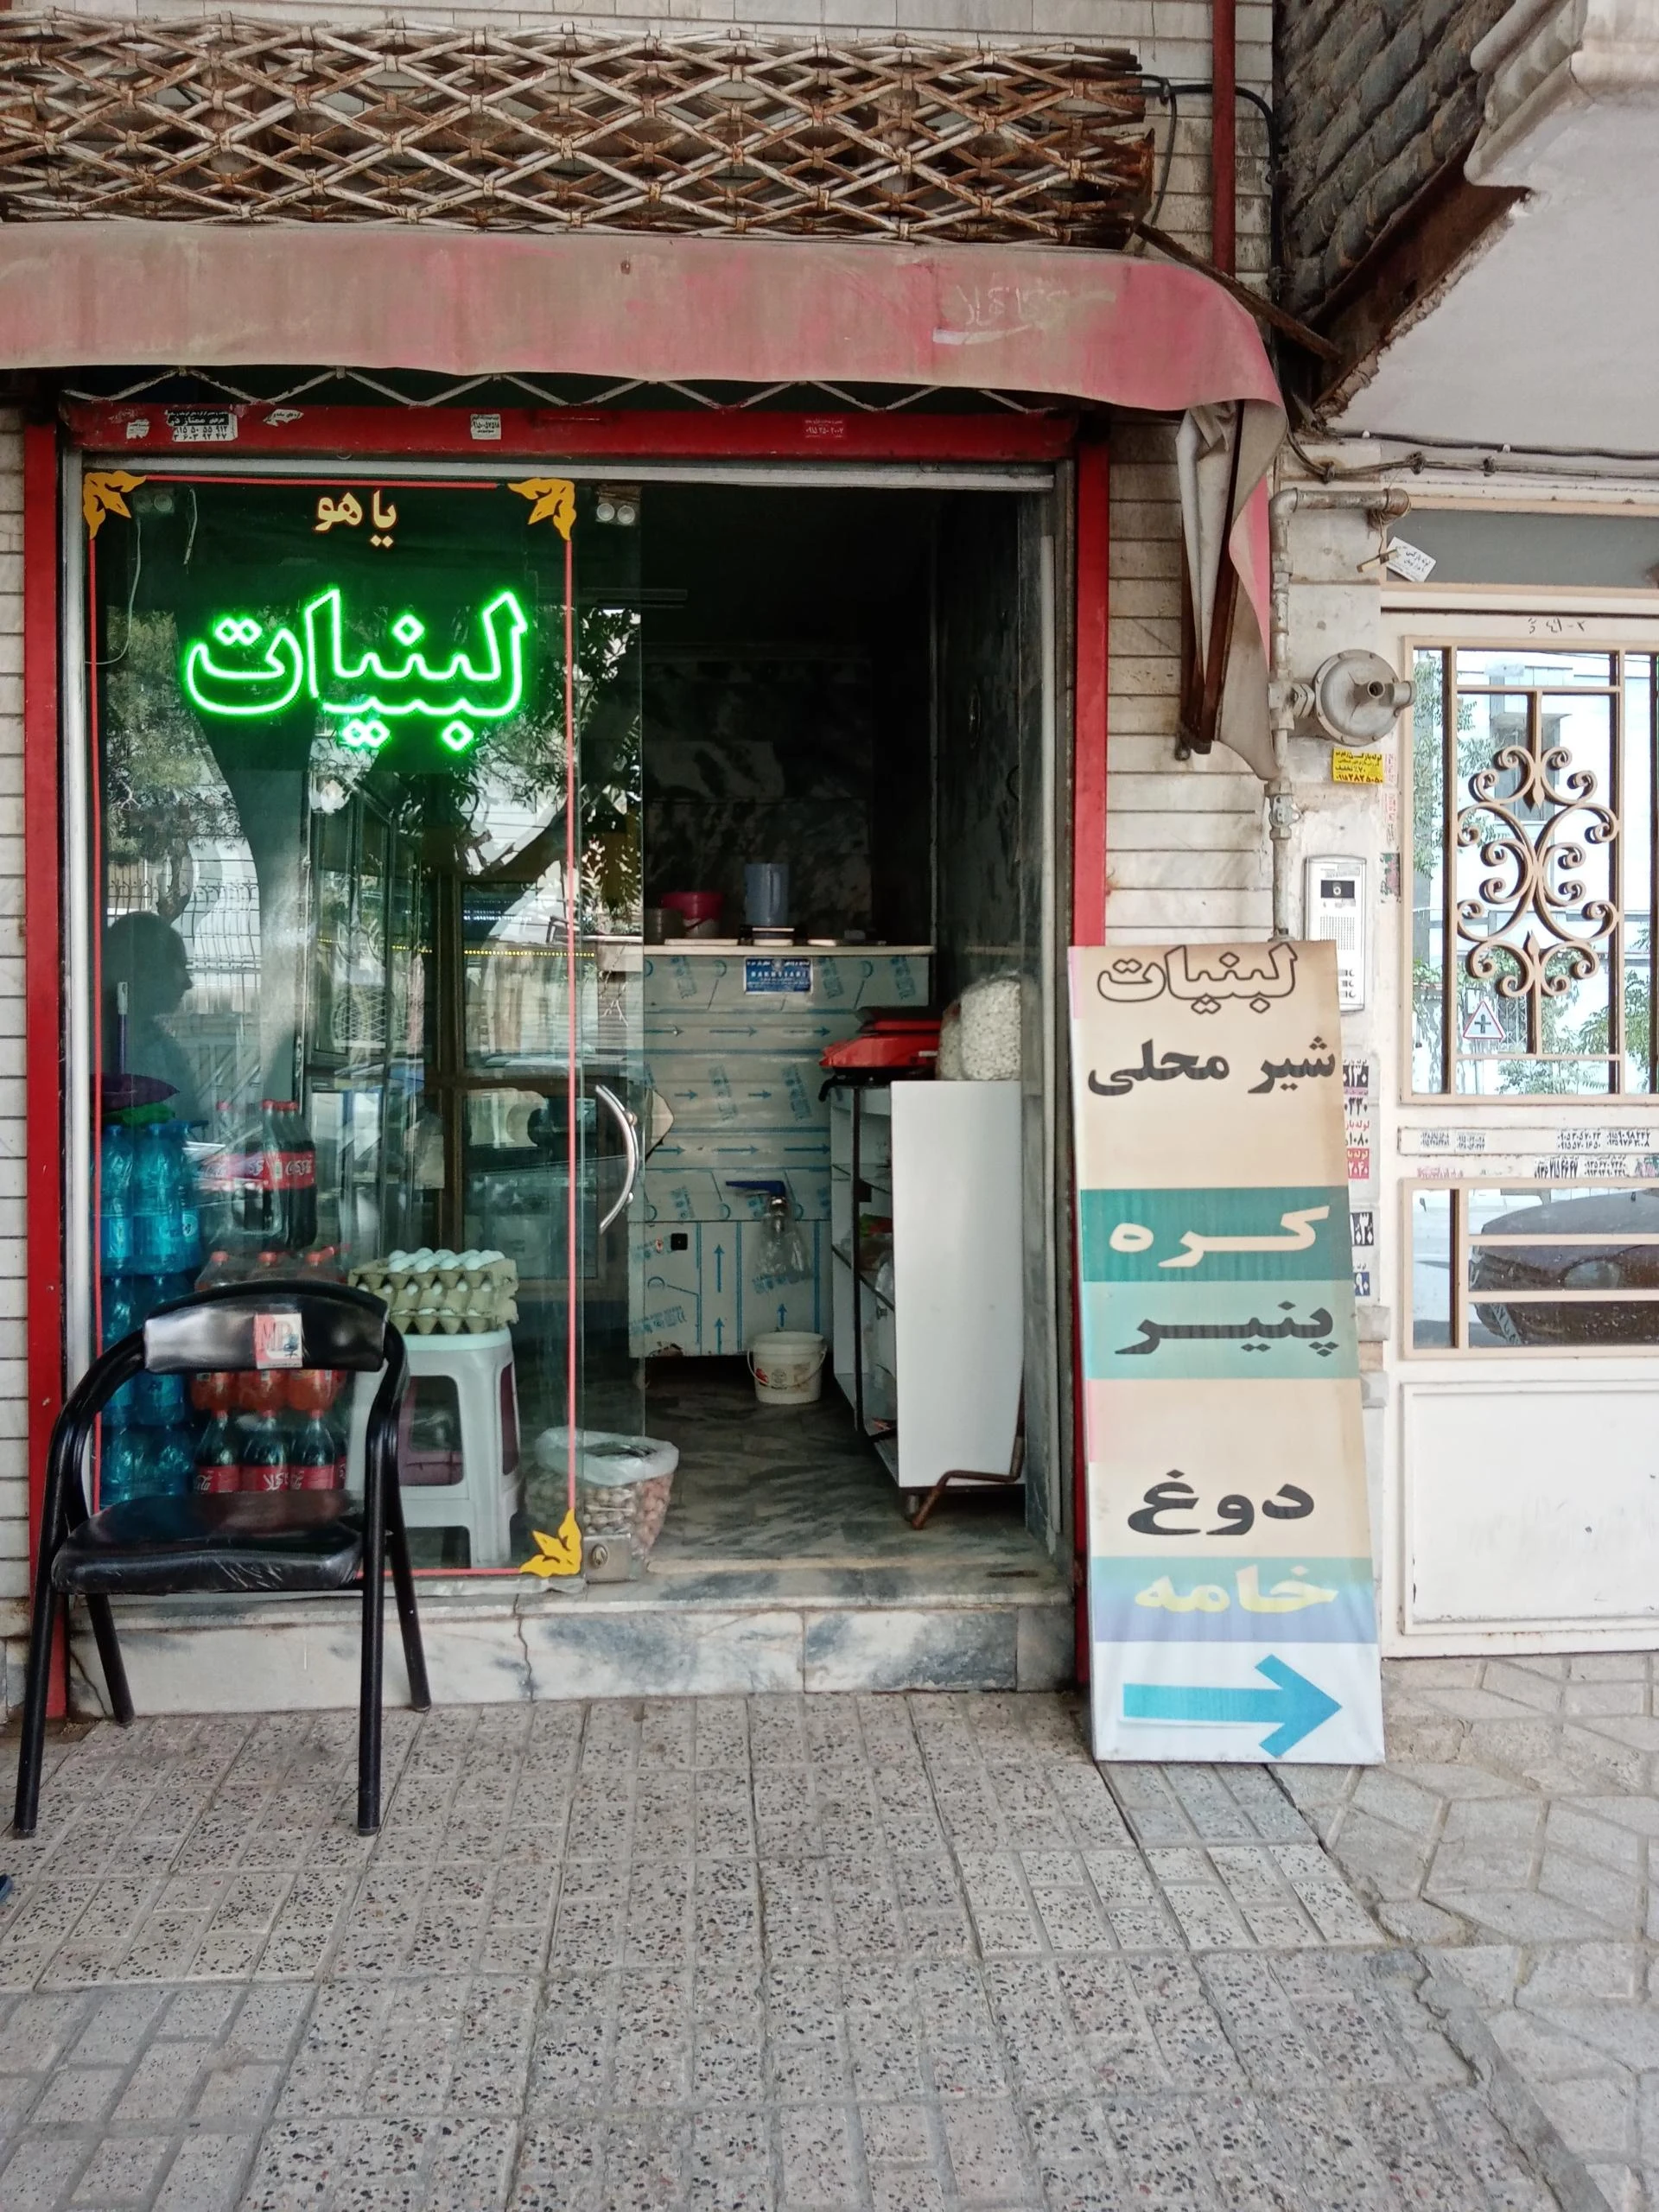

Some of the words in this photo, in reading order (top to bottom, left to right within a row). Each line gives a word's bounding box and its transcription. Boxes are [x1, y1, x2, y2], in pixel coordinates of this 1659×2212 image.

[313, 492, 363, 532] هو
[185, 584, 531, 753] لبنیات
[1096, 941, 1298, 1015] لبنیات
[1087, 1038, 1230, 1097] محلی
[1247, 1035, 1337, 1095] شیر
[1109, 1205, 1331, 1268] کره
[1114, 1300, 1339, 1357] پنیر
[1127, 1469, 1315, 1535] دوغ
[1134, 1564, 1339, 1614] خامه
